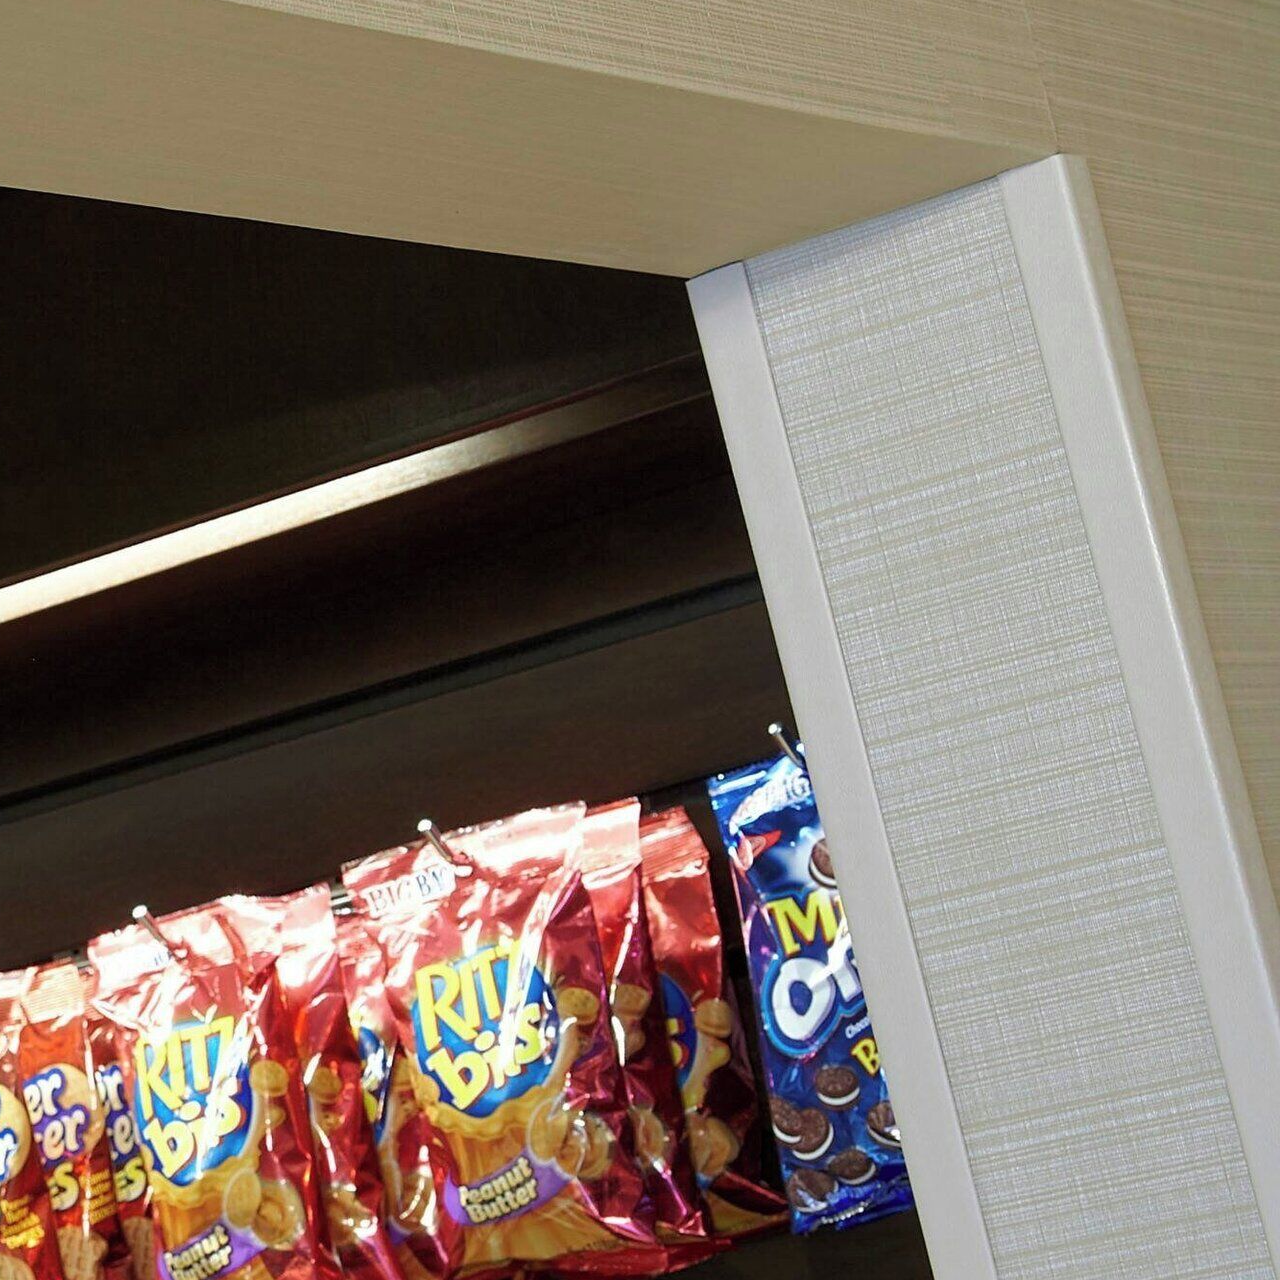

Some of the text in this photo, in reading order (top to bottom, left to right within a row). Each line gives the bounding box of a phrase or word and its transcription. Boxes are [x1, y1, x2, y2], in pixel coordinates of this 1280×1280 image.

[765, 888, 845, 957] M
[459, 1156, 533, 1208] Peanut
[465, 1179, 540, 1224] Butter
[164, 1224, 229, 1271] Peanut
